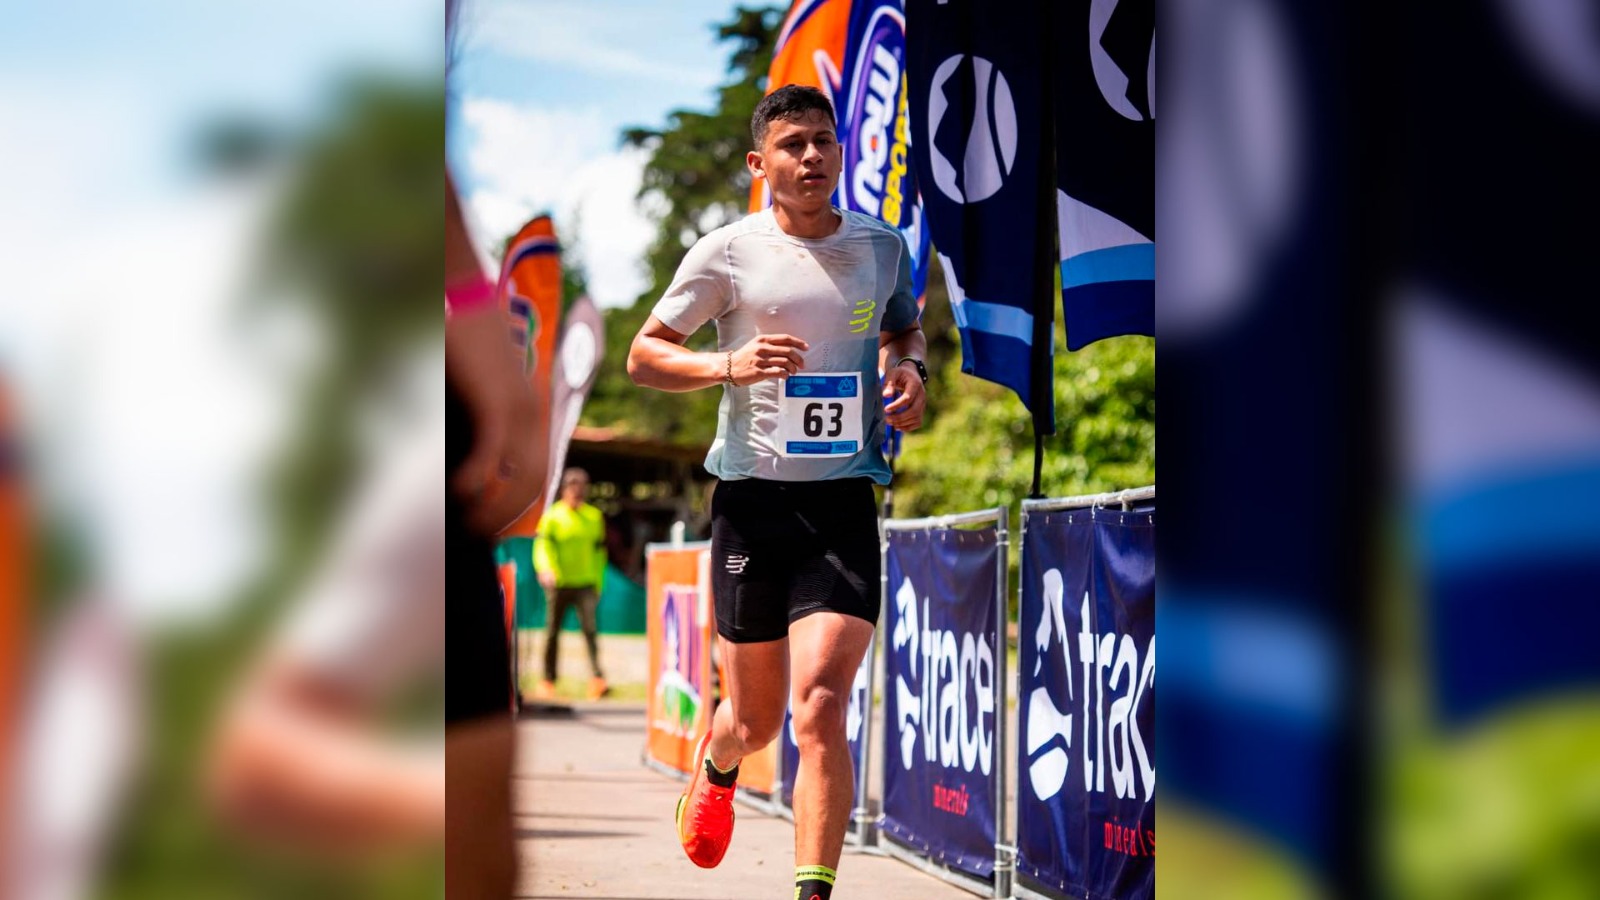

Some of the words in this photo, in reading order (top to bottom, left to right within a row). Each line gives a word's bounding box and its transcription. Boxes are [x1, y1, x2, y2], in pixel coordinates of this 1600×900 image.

[882, 69, 907, 227] SPOR
[803, 402, 843, 437] 63
[921, 596, 993, 776] trace
[932, 782, 969, 816] minerals
